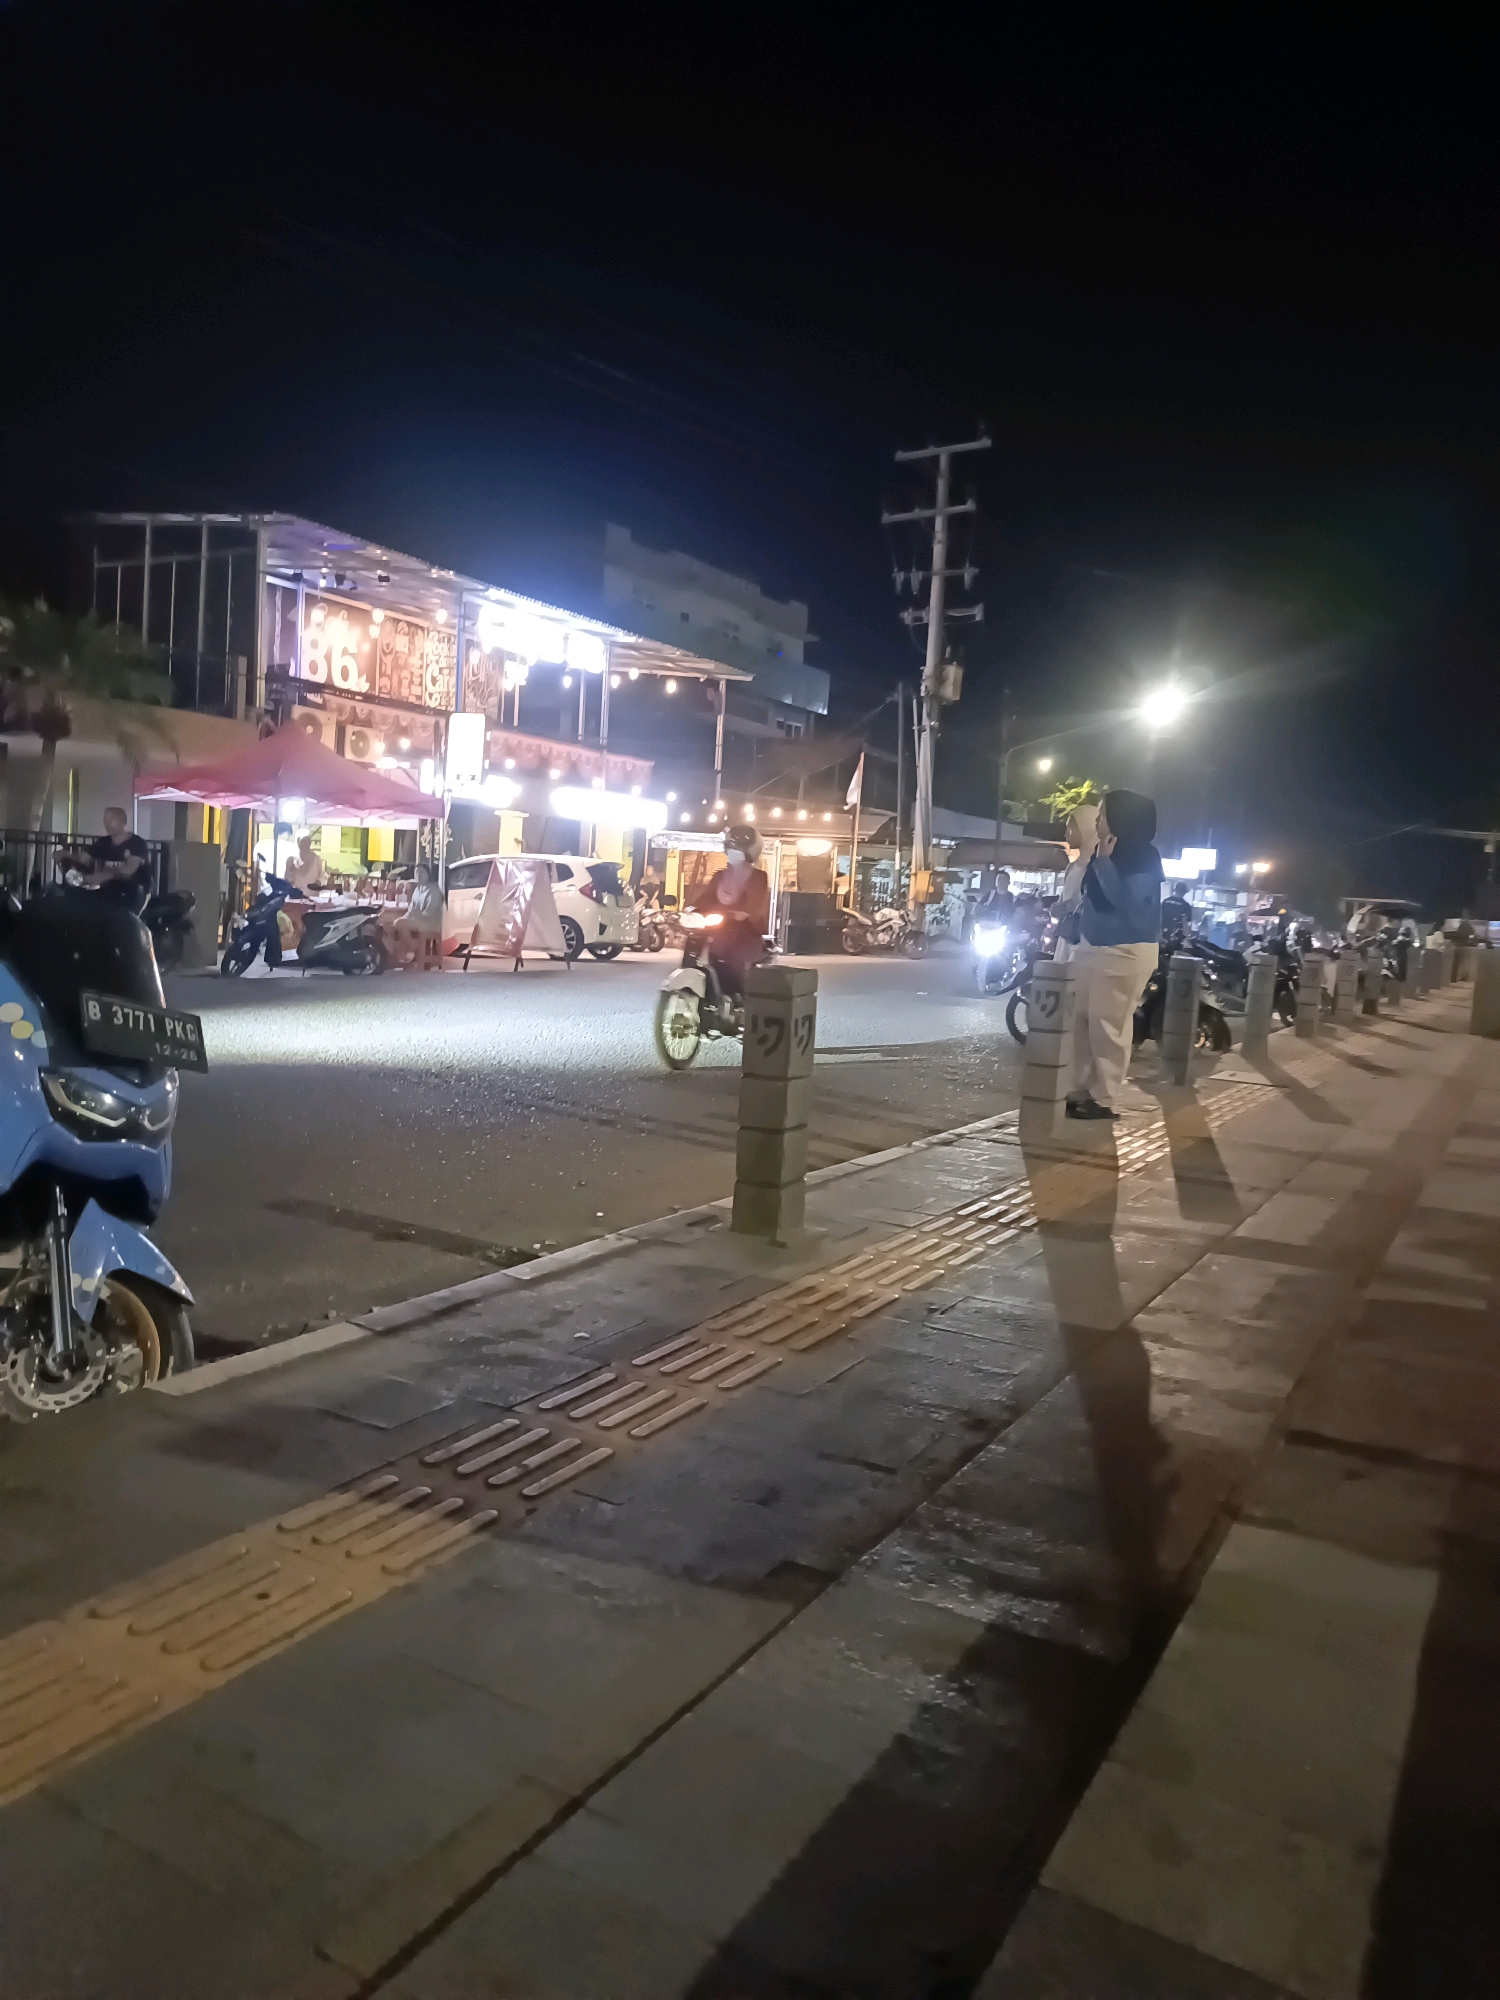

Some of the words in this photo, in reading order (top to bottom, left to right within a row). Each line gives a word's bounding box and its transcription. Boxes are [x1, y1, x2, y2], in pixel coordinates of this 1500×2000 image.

[301, 627, 359, 690] 86
[88, 1000, 101, 1020] B
[112, 1006, 155, 1033] 3771
